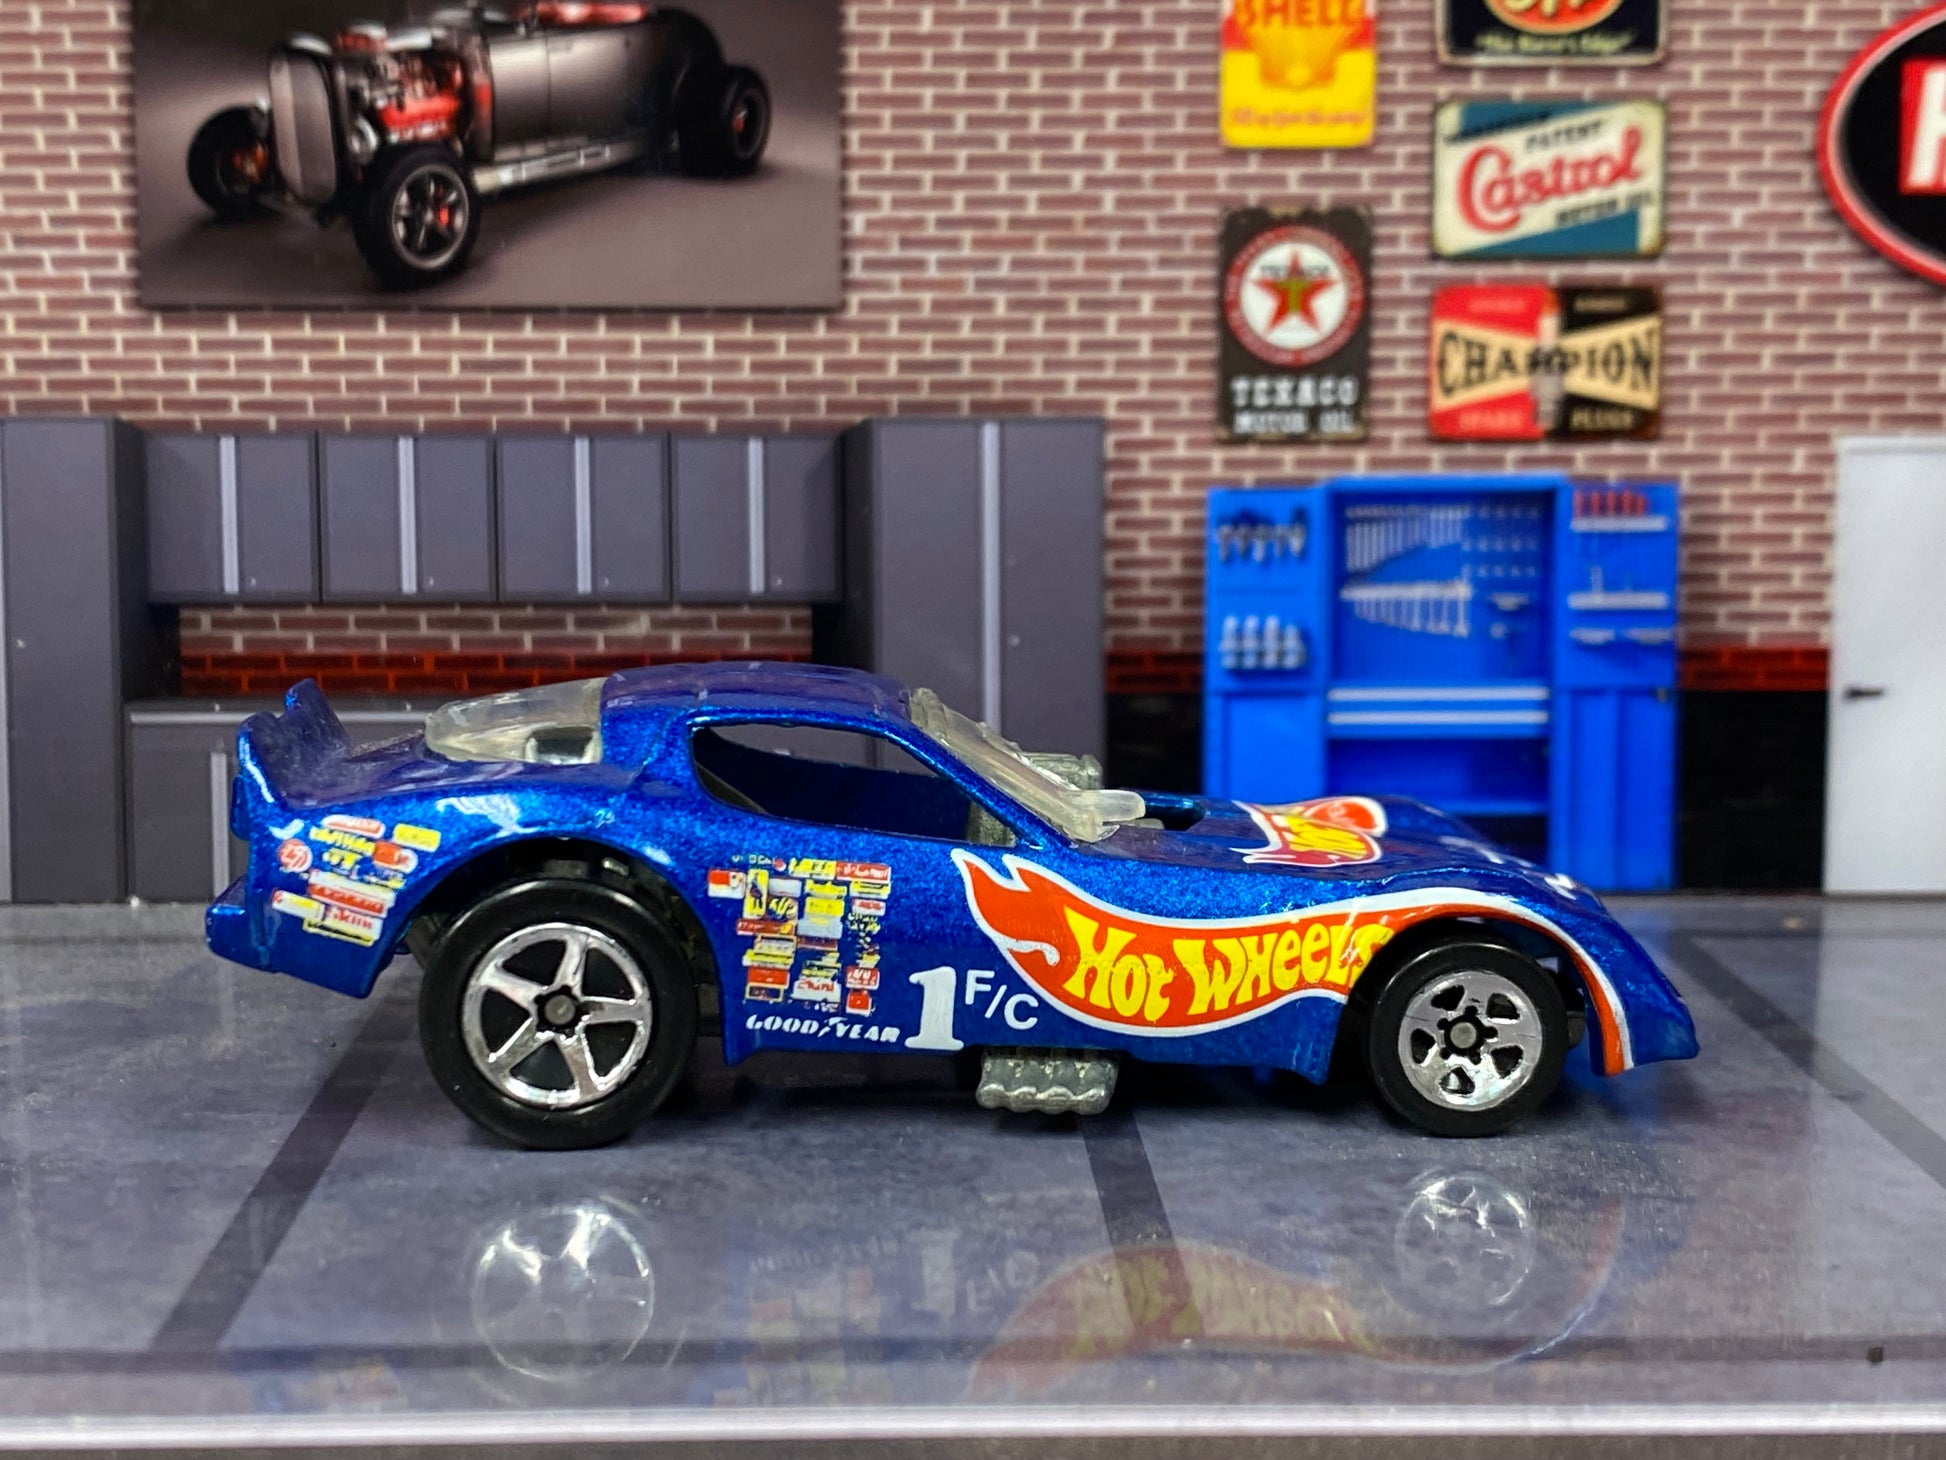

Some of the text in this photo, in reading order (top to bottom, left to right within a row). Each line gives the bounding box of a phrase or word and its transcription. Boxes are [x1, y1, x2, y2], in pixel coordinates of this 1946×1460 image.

[1456, 125, 1643, 235] Castrol
[1230, 374, 1360, 408] TEXACO
[1437, 324, 1655, 396] CHAMPION
[1062, 904, 1175, 1023] Hot
[904, 965, 1039, 1050] 1 F/C
